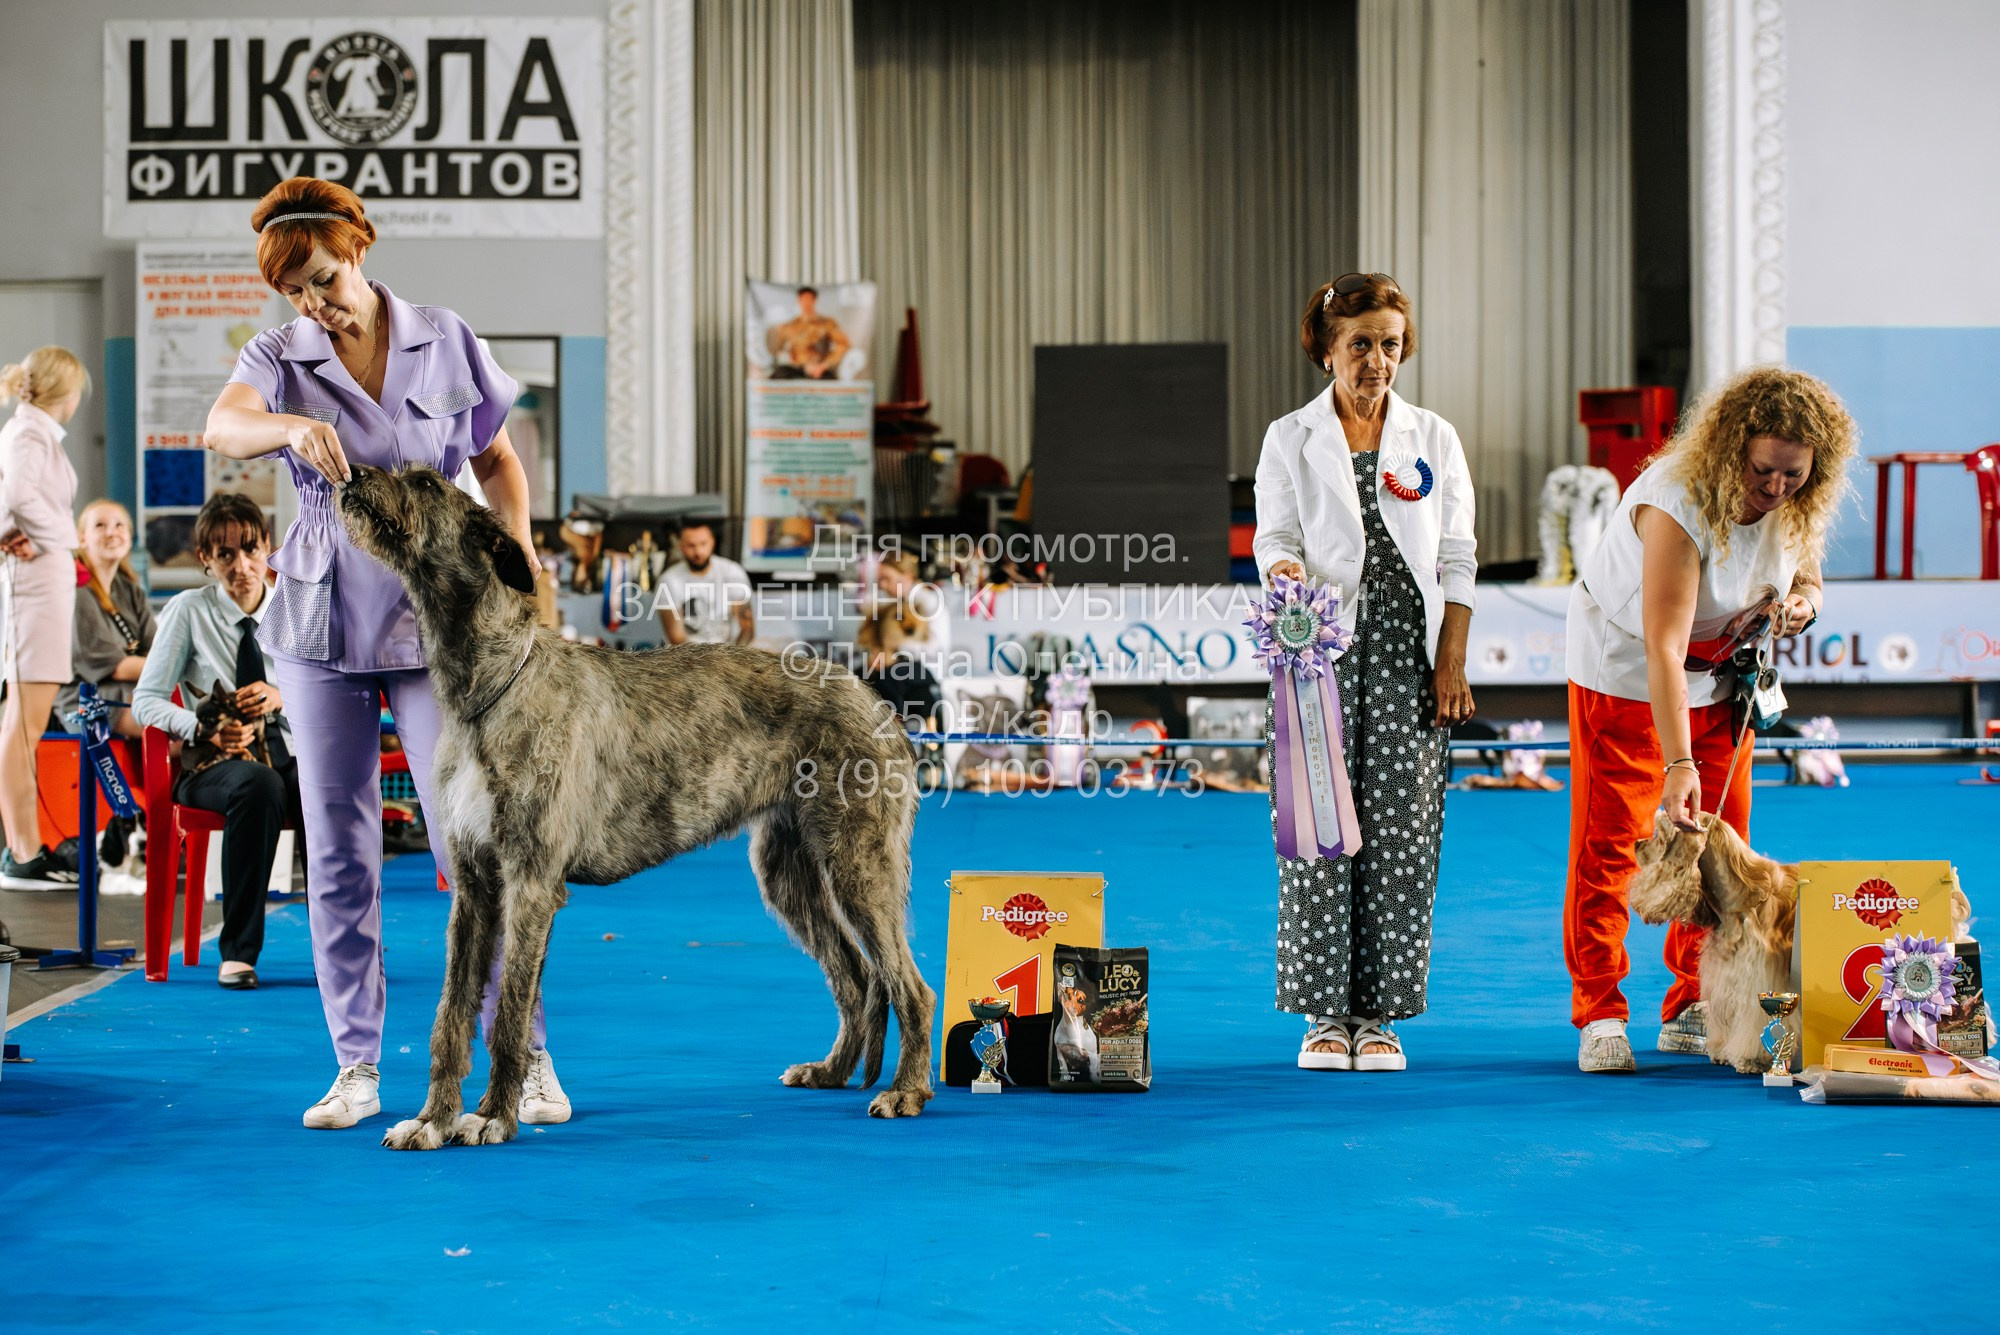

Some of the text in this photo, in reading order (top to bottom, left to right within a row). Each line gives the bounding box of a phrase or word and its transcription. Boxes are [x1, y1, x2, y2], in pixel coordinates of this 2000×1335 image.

[129, 35, 580, 142] ШКОЛА
[130, 152, 580, 197] ФИГУРАНТОВ
[981, 905, 1069, 926] Pedigree
[1832, 892, 1919, 913] Pedigree
[992, 953, 1041, 1017] 1
[1099, 976, 1142, 993] LUCY
[1840, 943, 1887, 1041] 2
[1869, 1057, 1913, 1069] Electronic
